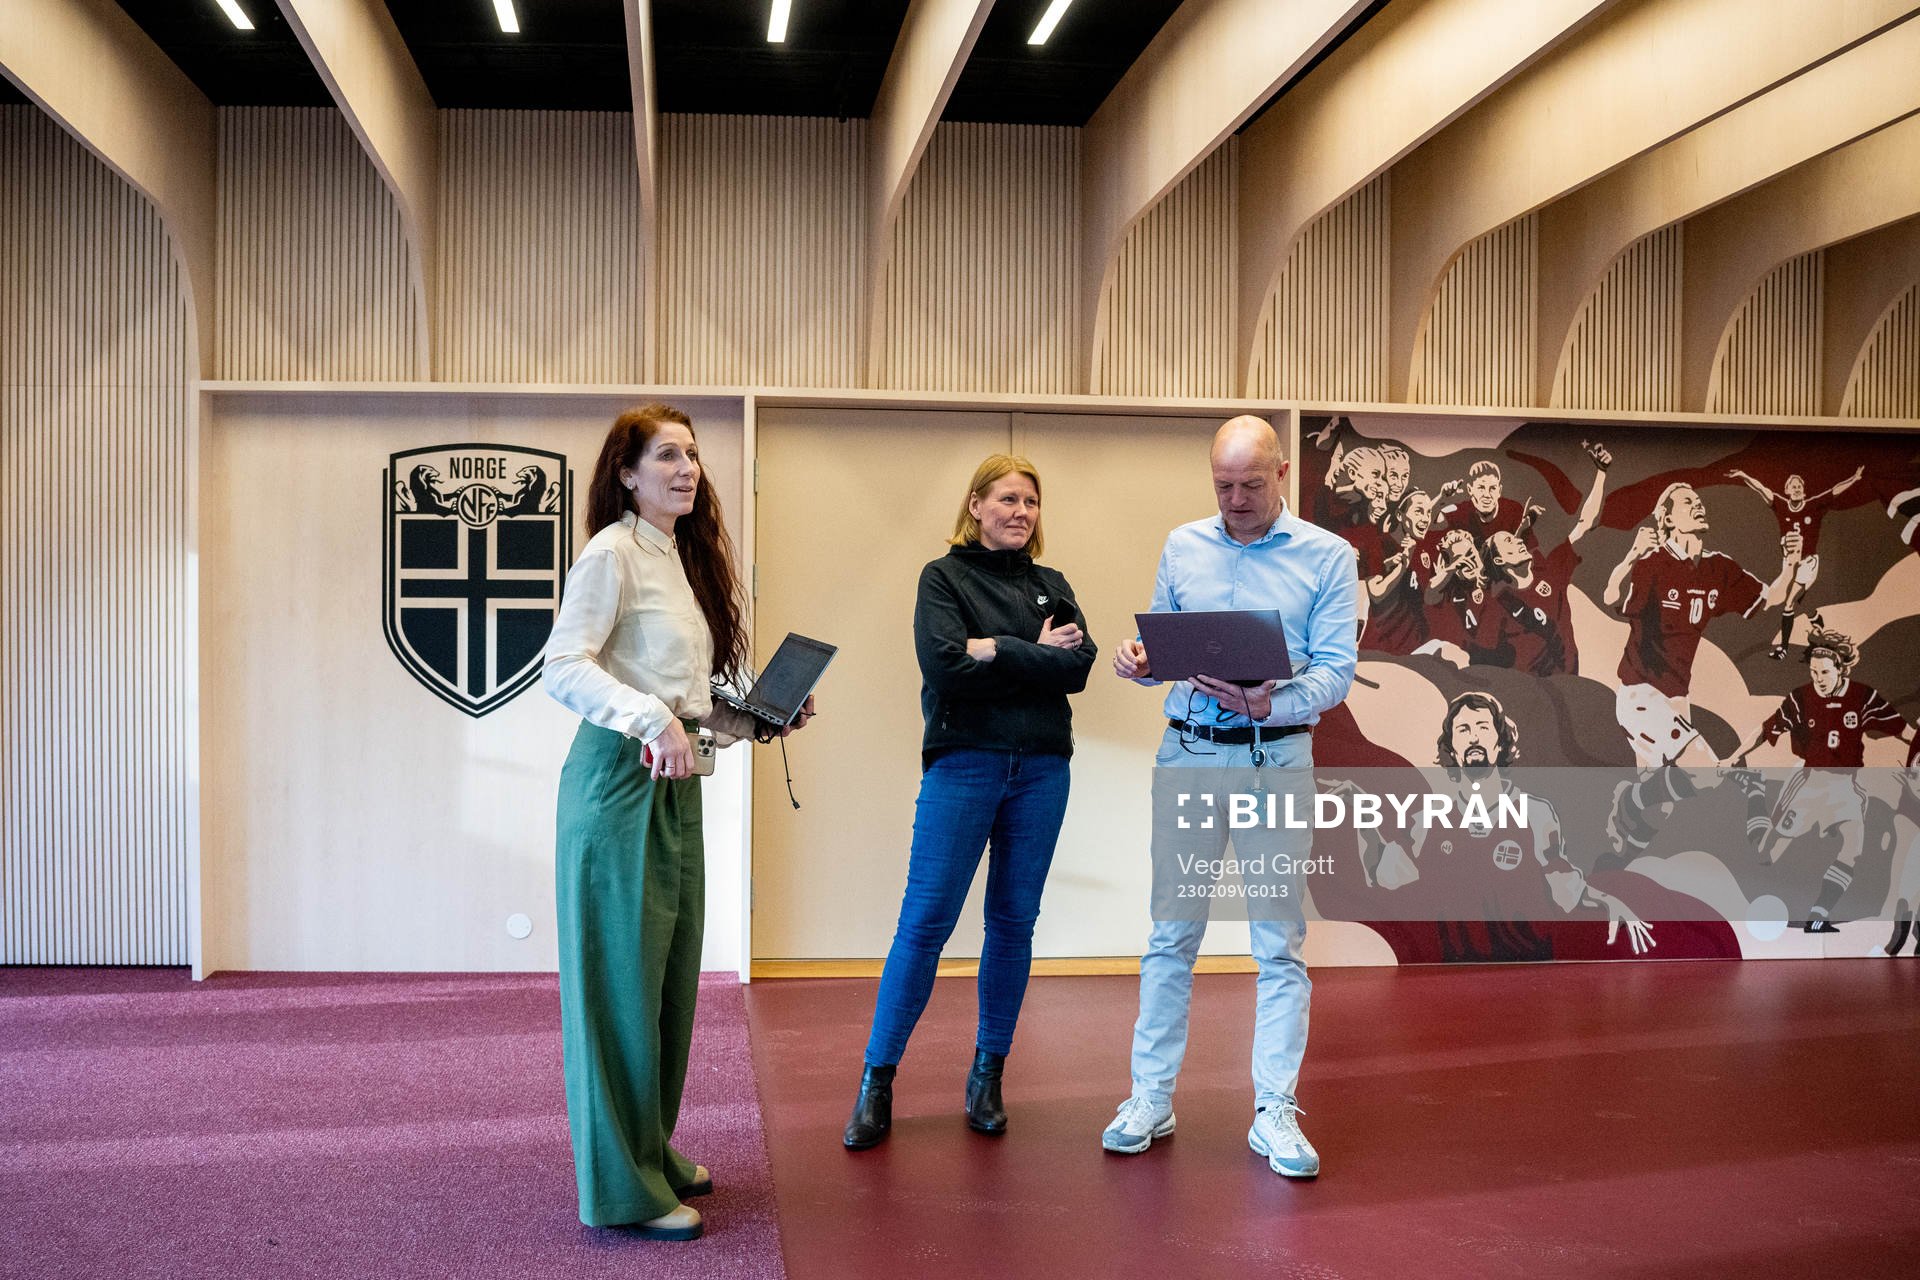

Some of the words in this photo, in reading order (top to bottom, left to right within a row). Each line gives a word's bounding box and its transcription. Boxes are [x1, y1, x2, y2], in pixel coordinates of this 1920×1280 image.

[450, 457, 506, 479] NORGE
[461, 488, 496, 523] NFF
[1409, 570, 1418, 590] 4
[1533, 607, 1547, 626] 9
[1689, 597, 1704, 625] 10
[1827, 730, 1840, 749] 6
[1781, 809, 1797, 830] 6
